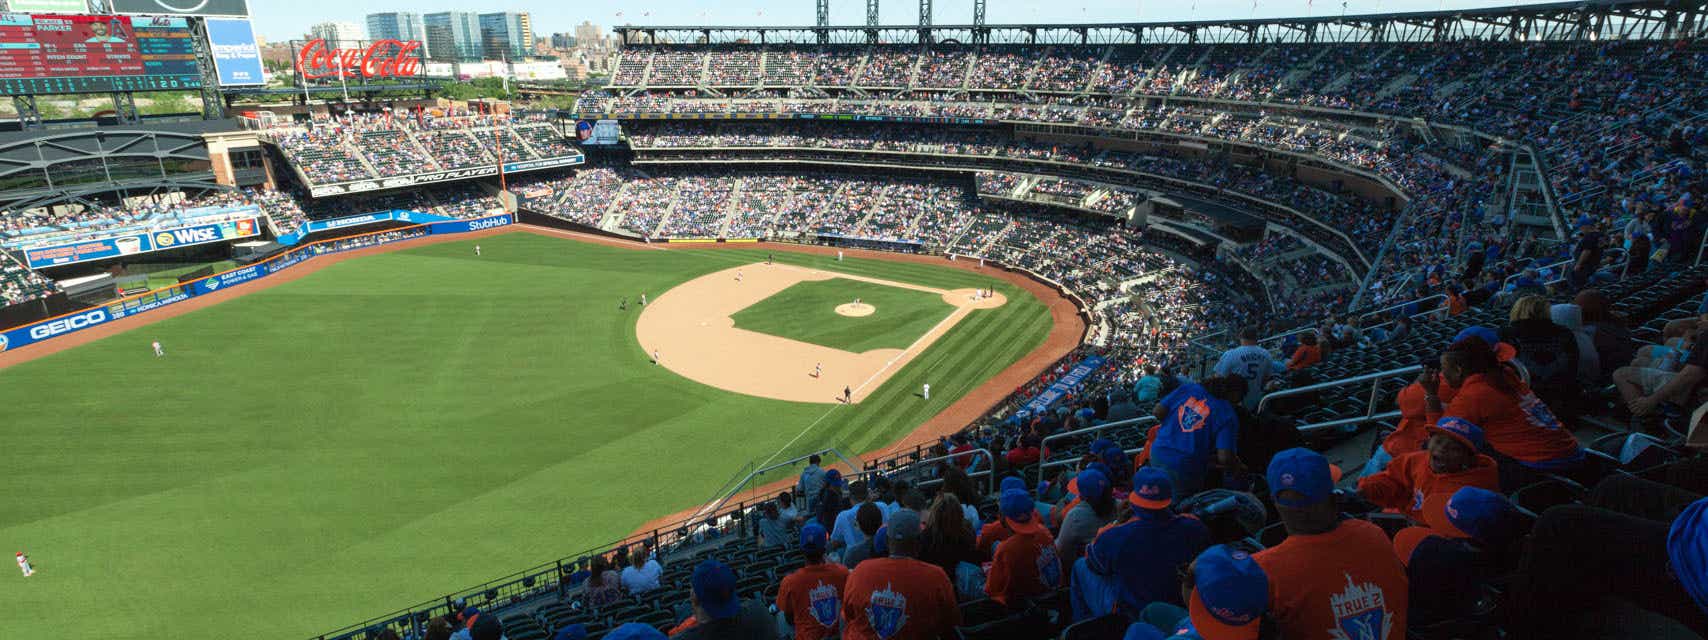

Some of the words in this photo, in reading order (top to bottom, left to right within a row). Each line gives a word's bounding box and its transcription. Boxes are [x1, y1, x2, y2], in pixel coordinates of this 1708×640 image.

[415, 173, 444, 183] PRO
[445, 166, 496, 180] PLAYER
[468, 217, 507, 231] StubHub
[173, 227, 218, 244] WISE
[221, 271, 237, 281] EAST
[237, 266, 256, 276] COAST
[30, 310, 106, 340] GEICO
[1246, 363, 1259, 380] 5
[1335, 596, 1369, 617] TRUE
